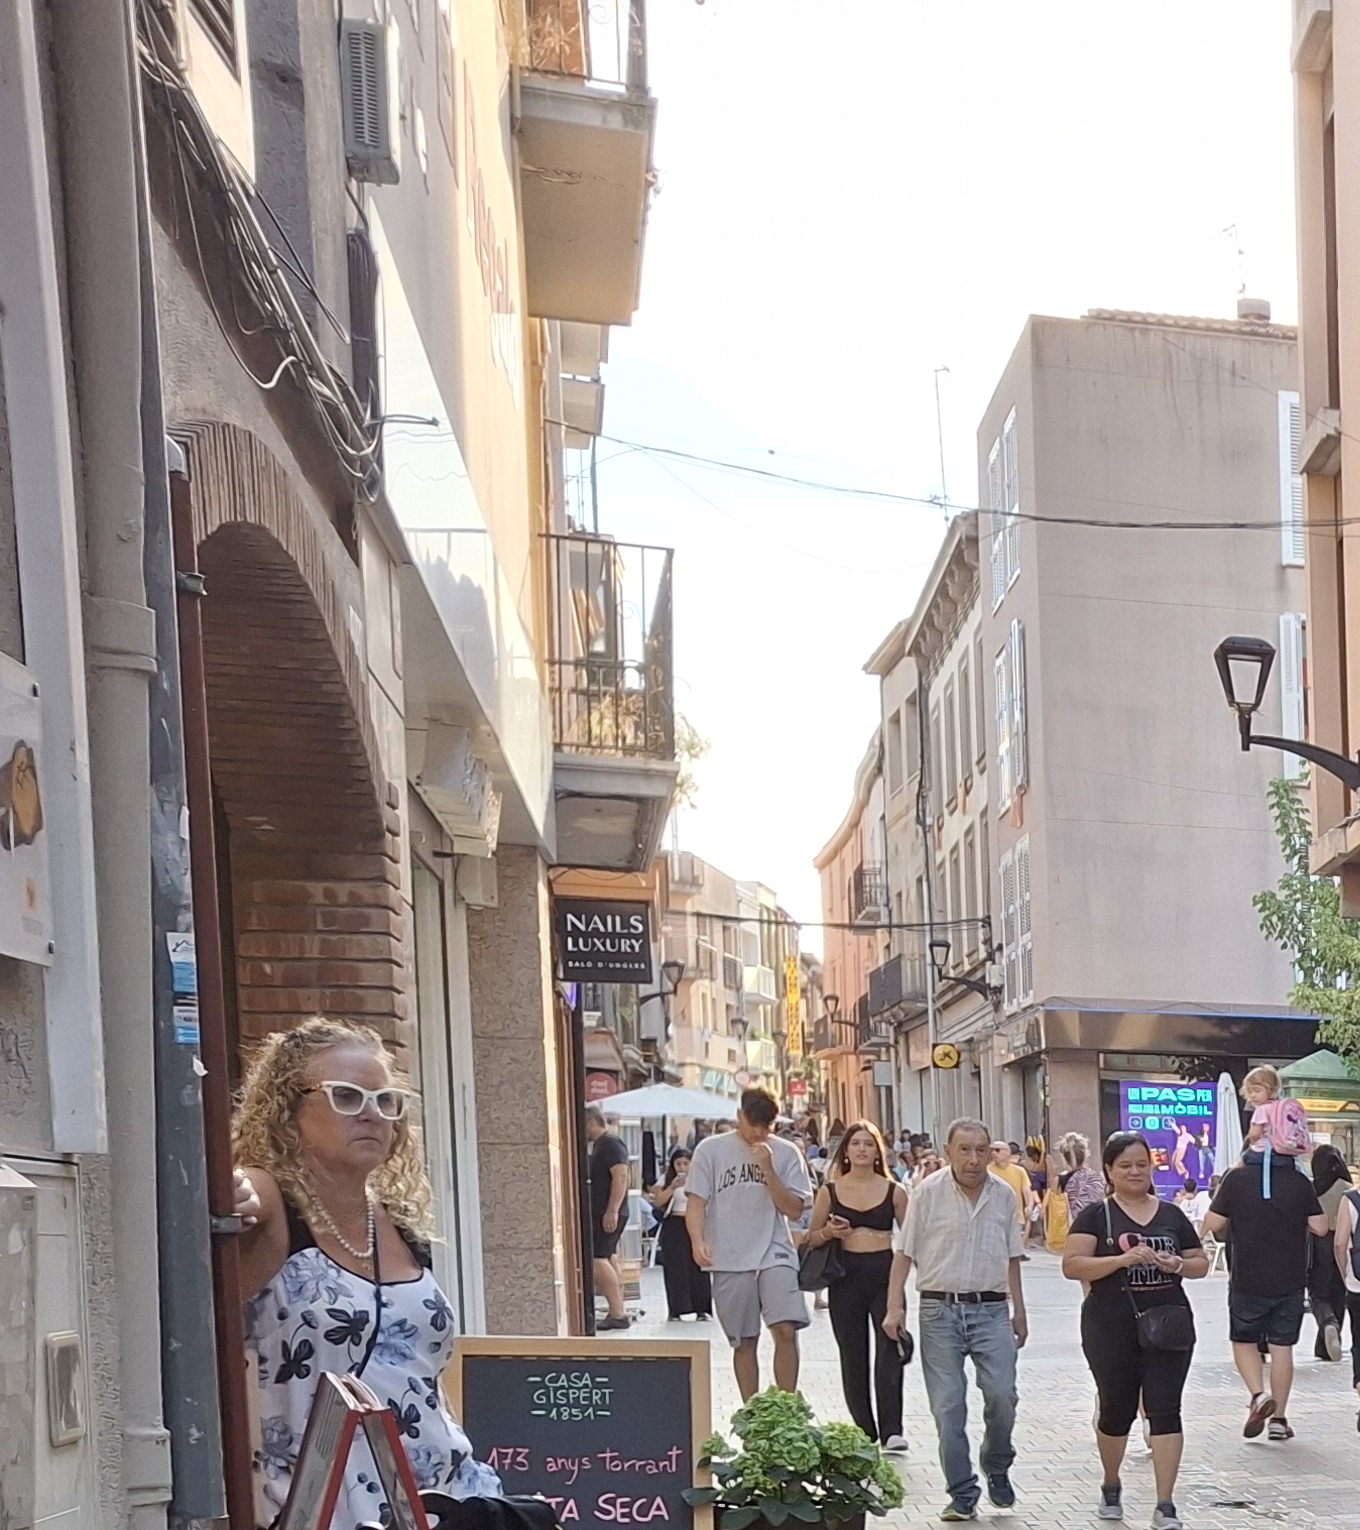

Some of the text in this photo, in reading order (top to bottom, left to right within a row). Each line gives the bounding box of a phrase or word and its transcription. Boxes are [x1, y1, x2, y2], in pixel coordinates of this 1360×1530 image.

[566, 912, 644, 934] NAILS
[567, 936, 643, 952] LUXURY
[1141, 1087, 1196, 1101] PAS
[1160, 1103, 1213, 1116] MÒBIL
[717, 1166, 736, 1193] LOS
[544, 1372, 593, 1388] CASA
[532, 1387, 614, 1405] GISPERT
[548, 1407, 596, 1422] 1851
[486, 1446, 530, 1472] 173
[545, 1456, 593, 1486] anys
[593, 1492, 670, 1524] SECA
